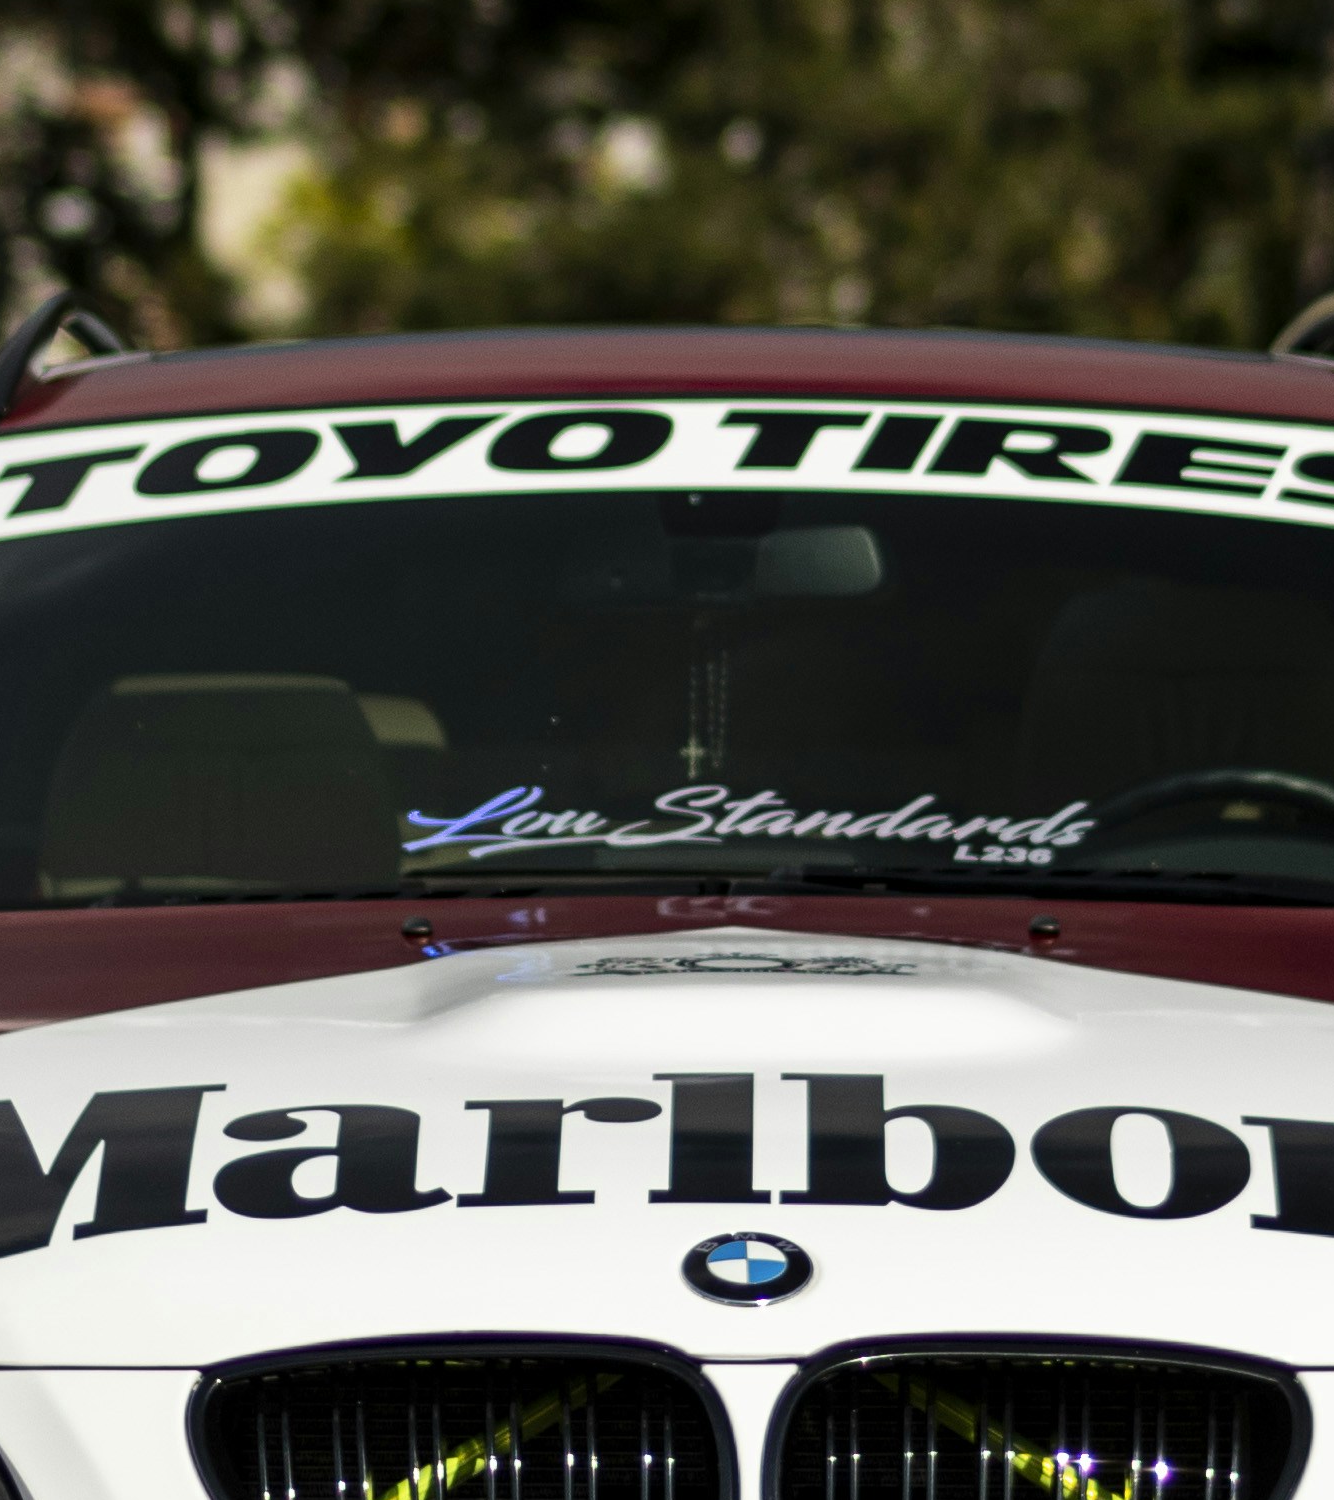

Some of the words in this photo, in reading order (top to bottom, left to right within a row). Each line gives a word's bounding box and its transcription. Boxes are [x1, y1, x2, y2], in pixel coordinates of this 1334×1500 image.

[612, 785, 1096, 846] Standards
[953, 844, 1053, 865] L236
[695, 1231, 799, 1253] BMW
